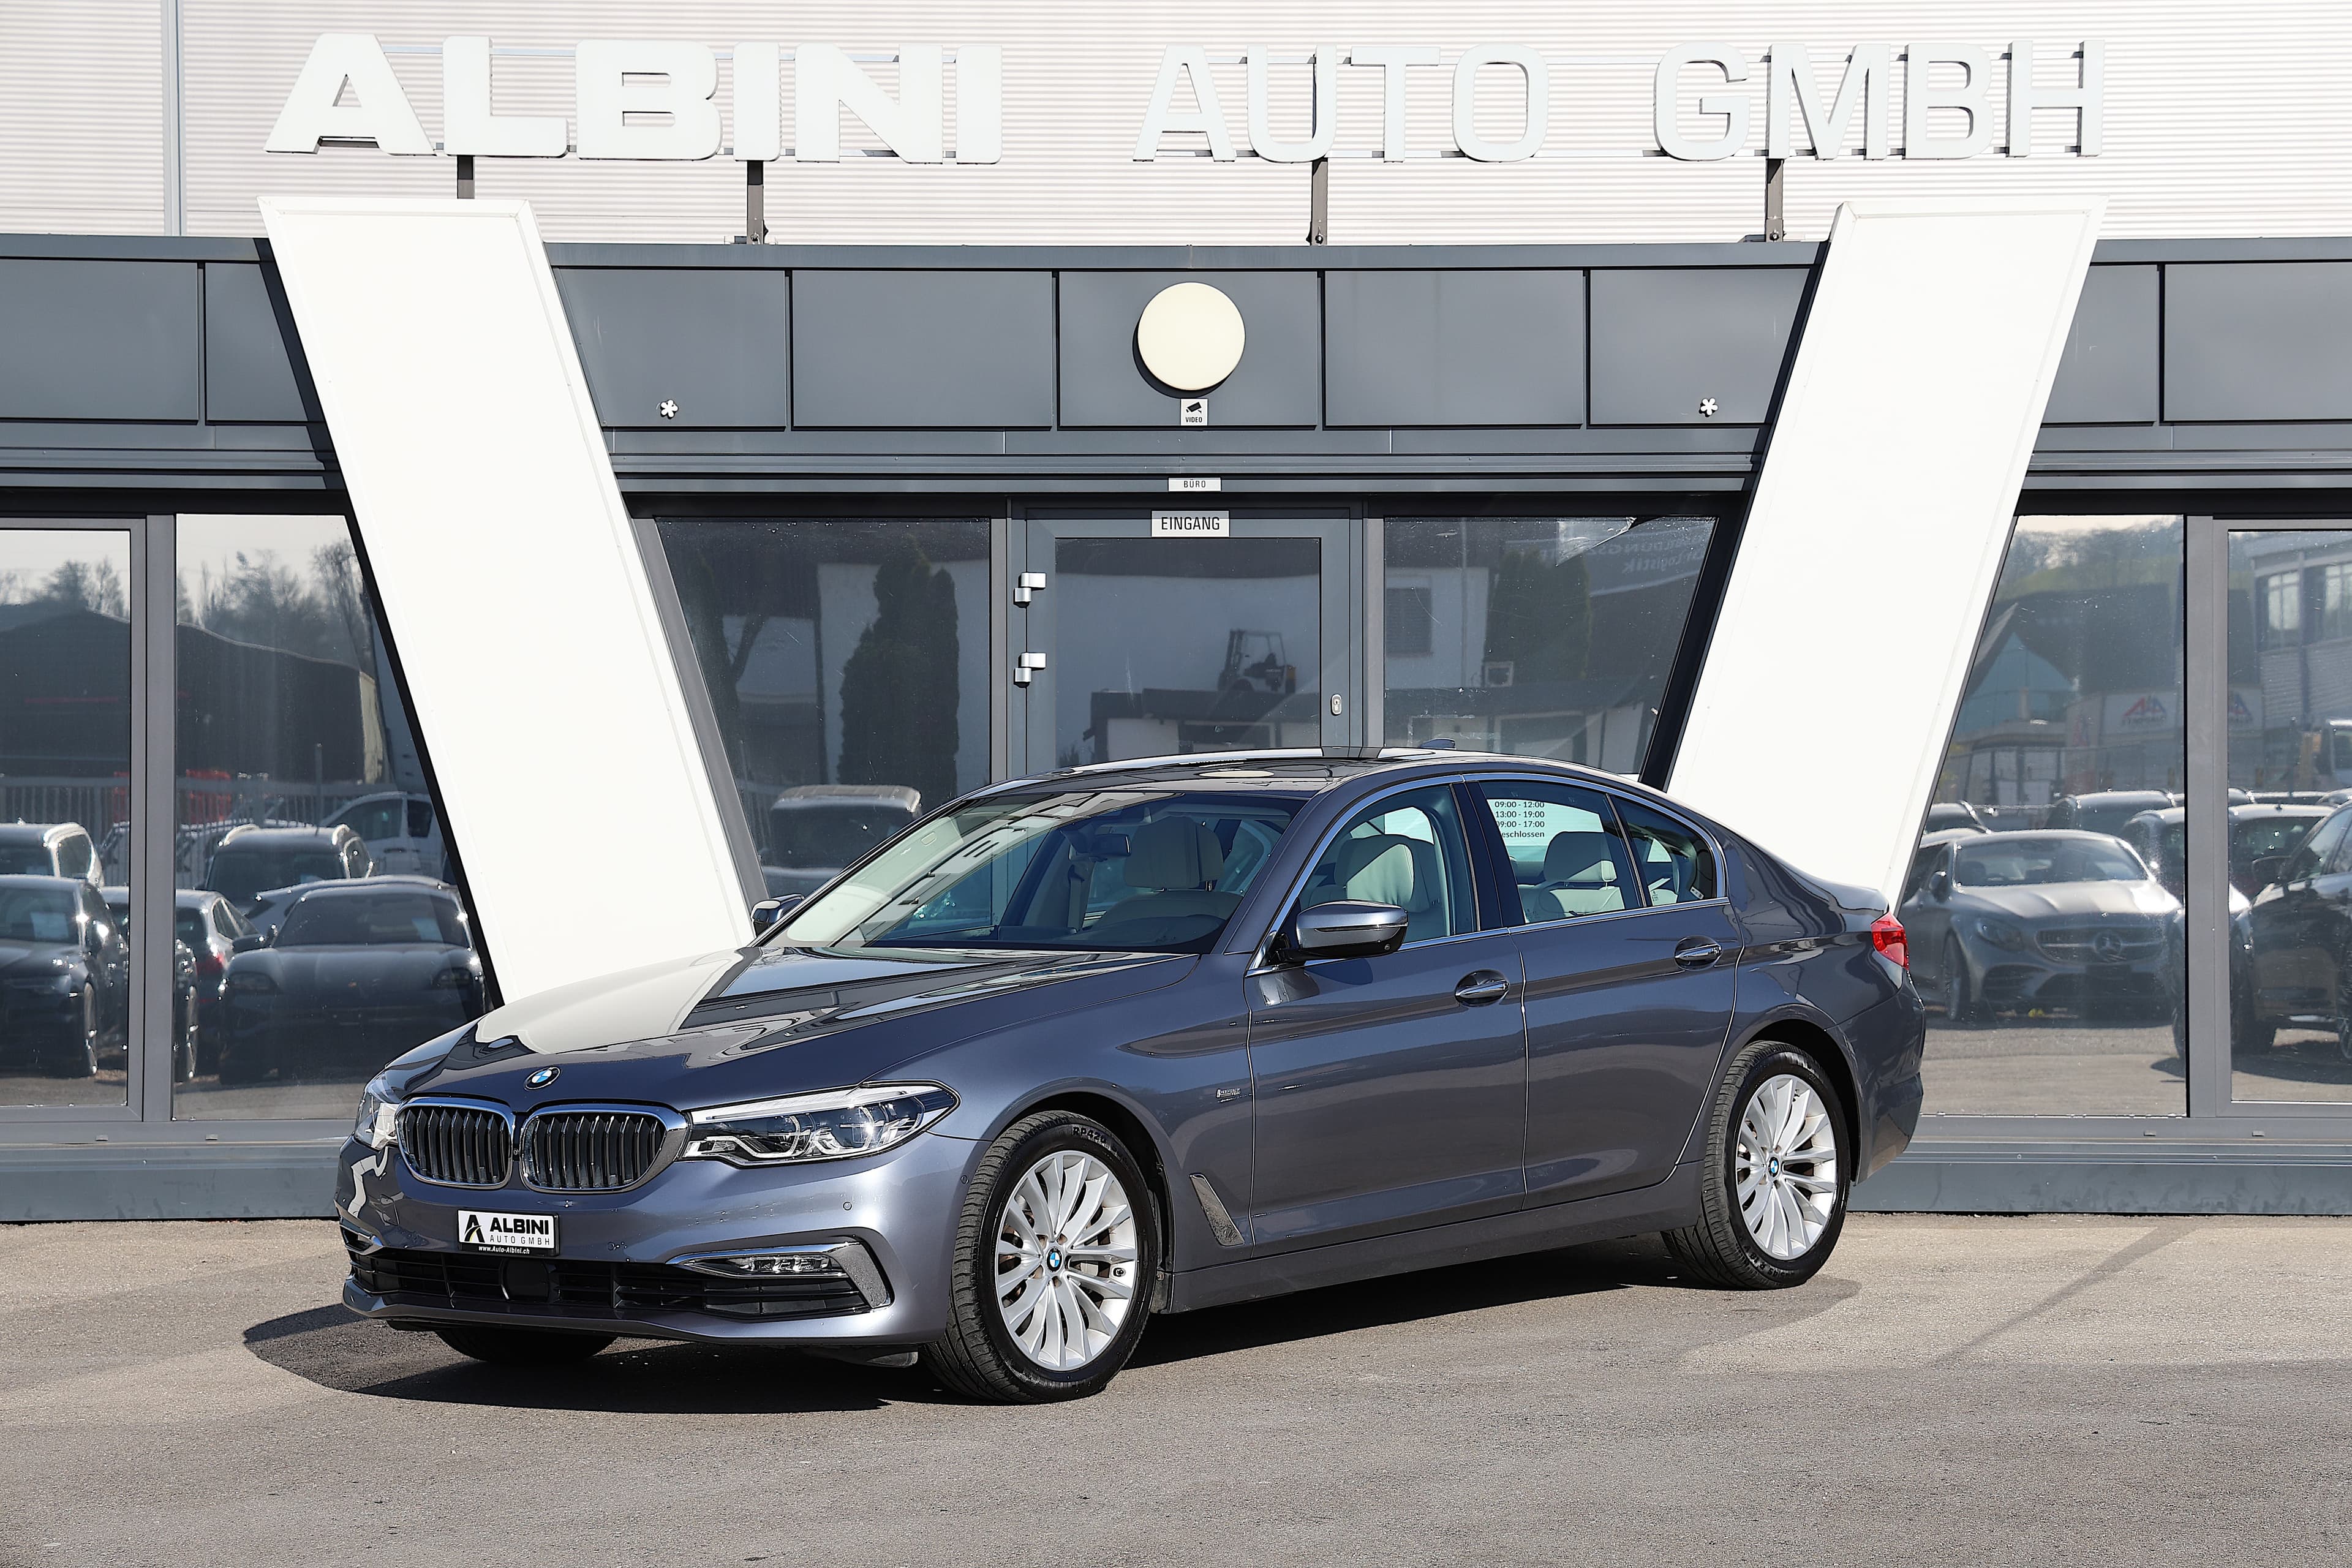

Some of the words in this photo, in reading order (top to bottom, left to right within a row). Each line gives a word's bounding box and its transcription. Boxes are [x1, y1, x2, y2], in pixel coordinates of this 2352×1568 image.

[265, 32, 1003, 164] ALBINI
[1133, 43, 1550, 163] AUTO
[1653, 39, 2106, 161] GMBH
[1183, 478, 1206, 488] BÜRO
[1161, 516, 1220, 530] EINGANG
[490, 1217, 549, 1235] ALBINI
[490, 1235, 516, 1244] AUTO
[521, 1237, 549, 1245] GMBH
[478, 1245, 530, 1254] www.Auto-Albini.ch
